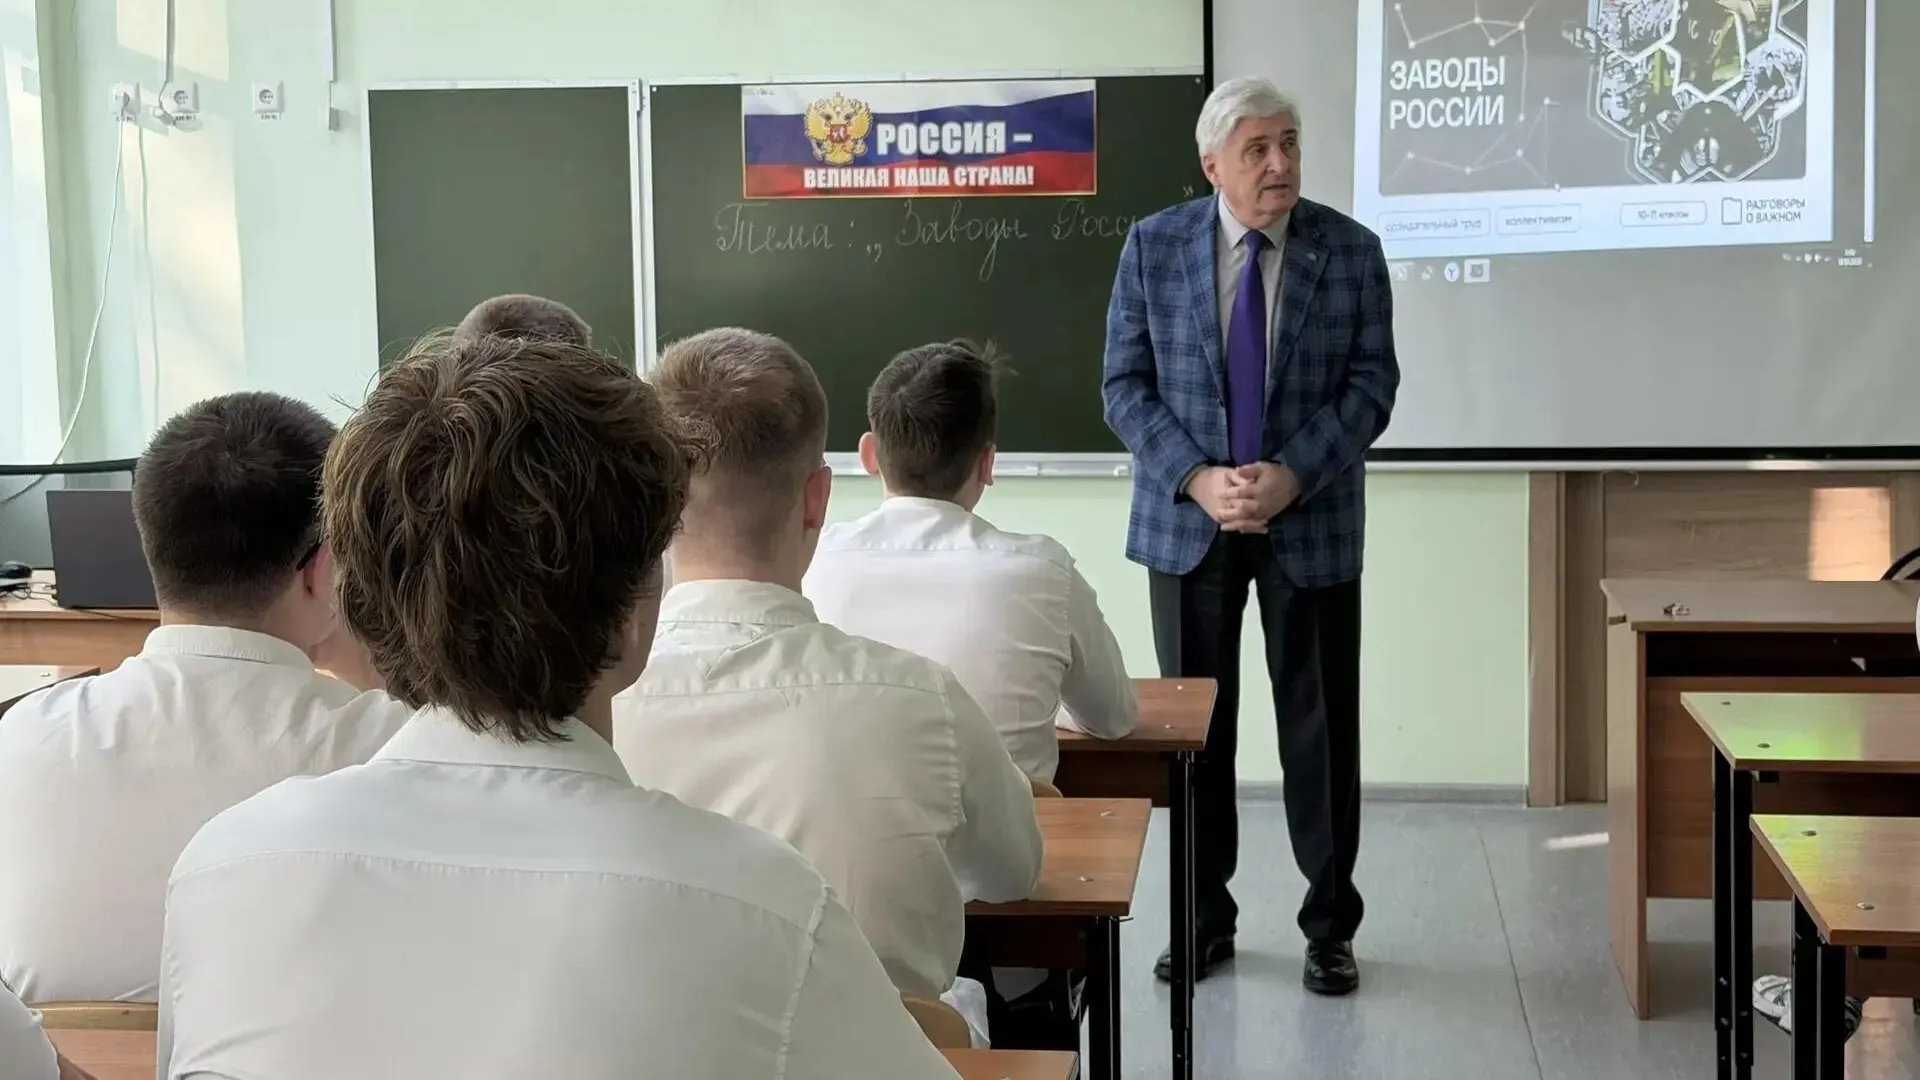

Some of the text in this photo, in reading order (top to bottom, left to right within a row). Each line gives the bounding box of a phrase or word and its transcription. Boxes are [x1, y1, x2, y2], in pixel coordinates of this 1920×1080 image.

[1389, 55, 1506, 93] ЗАВОДЫ
[1389, 94, 1505, 130] РОССИИ
[876, 121, 1007, 156] РОССИЯ
[803, 165, 1034, 190] ВЕЛИКАЯ НАША СТРАНА!
[1746, 198, 1806, 210] РАЗГОВОРЫ
[1746, 211, 1802, 223] О ВАЖНОМ
